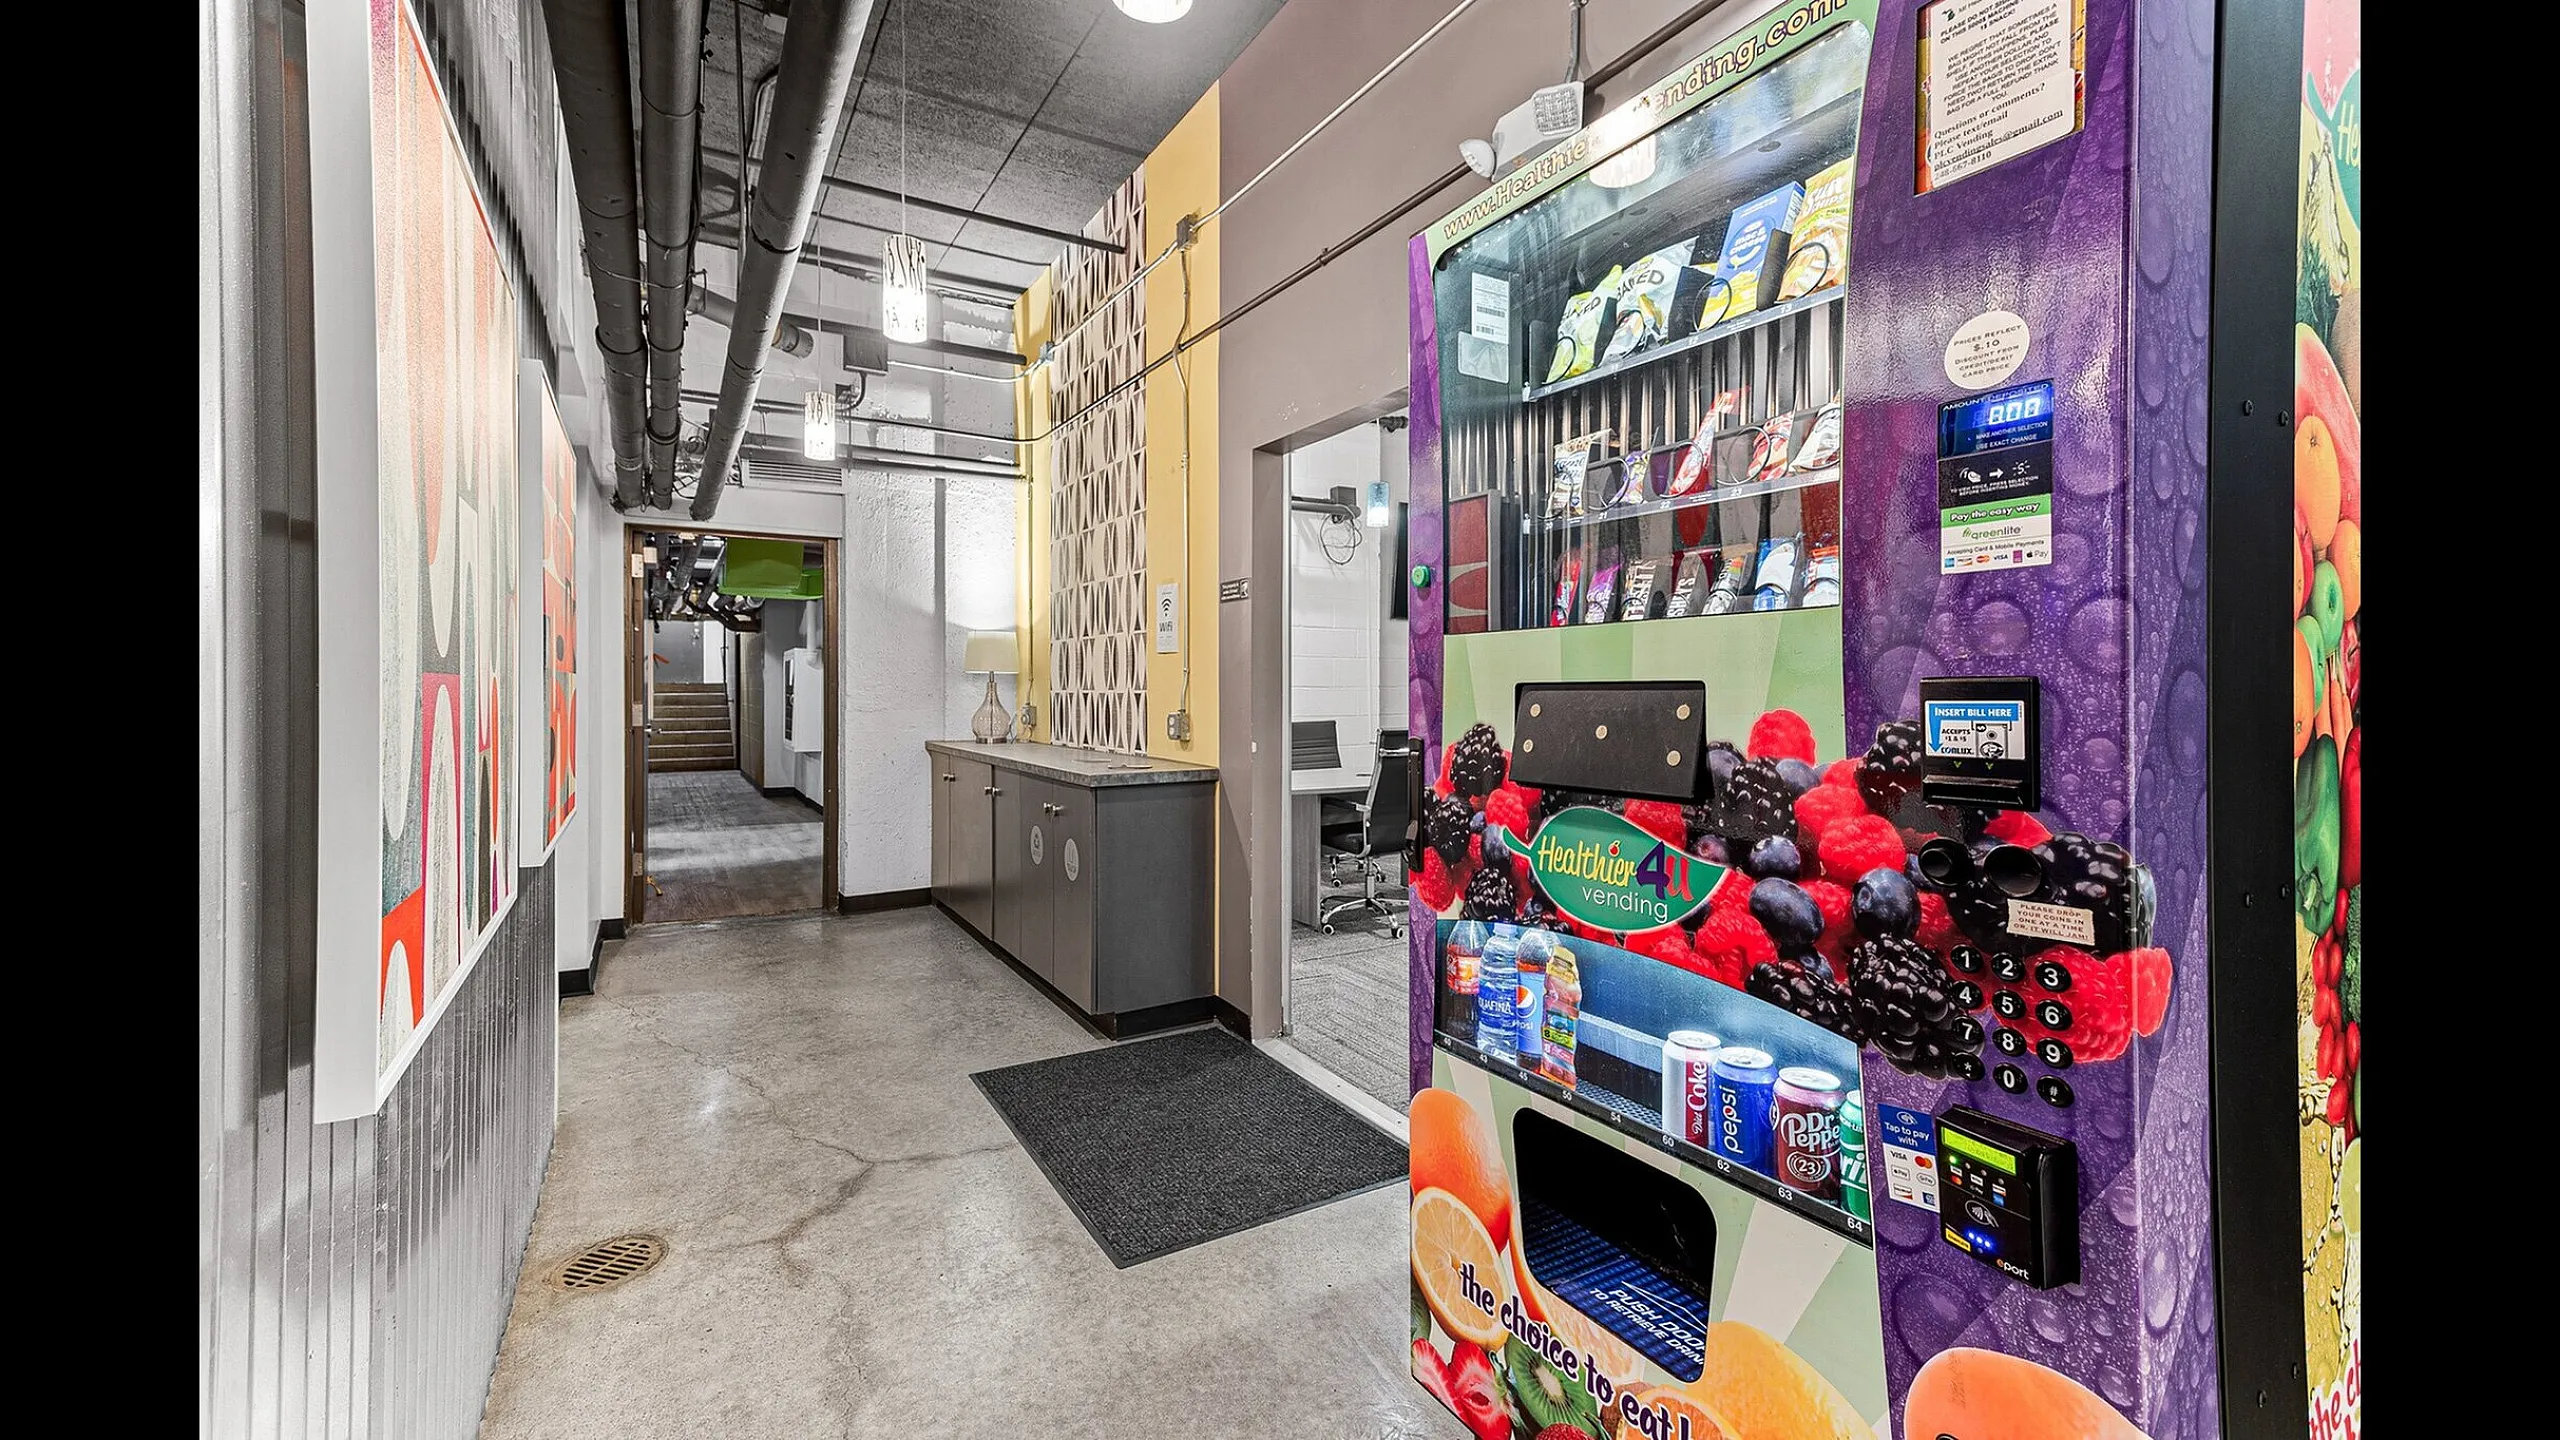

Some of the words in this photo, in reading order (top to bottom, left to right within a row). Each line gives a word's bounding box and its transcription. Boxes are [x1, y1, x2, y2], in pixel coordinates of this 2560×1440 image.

[1940, 19, 1966, 38] PLEASE
[1967, 13, 1977, 23] DO
[1980, 5, 1992, 16] NOT
[1948, 53, 1958, 63] WE
[1960, 38, 1987, 57] REGRET
[1989, 29, 2006, 42] THAT
[2008, 6, 2050, 33] SOMETIMES
[2051, 2, 2057, 10] A
[1940, 35, 1950, 45] ON
[1952, 26, 1966, 39] THIS
[1948, 59, 1961, 71] BAG
[1963, 48, 1983, 63] MIGHT
[1985, 39, 2000, 52] NOT
[2001, 30, 2017, 44] FALL
[2019, 19, 2040, 35] FROM
[2042, 10, 2057, 23] THE
[1977, 51, 1992, 64] THIS
[2029, 17, 2059, 37] PLEASE
[1952, 73, 1977, 91] REPEAT
[1979, 63, 1999, 78] YOUR
[2000, 42, 2040, 67] SELECTION
[2042, 37, 2052, 47] TO
[1955, 71, 1968, 82] USE
[1970, 54, 2002, 75] ANOTHER
[2004, 39, 2031, 58] DOLLAR
[2033, 30, 2049, 44] AND
[1944, 86, 1966, 102] FORCE
[1967, 79, 1981, 91] THE
[2005, 63, 2014, 73] TO
[1946, 104, 1961, 116] BAG
[1961, 97, 1976, 109] FOR
[1977, 94, 1982, 102] A
[1983, 86, 1999, 99] FULL
[2034, 58, 2059, 75] THANK
[1947, 94, 1966, 108] NEED
[1987, 70, 2016, 89] RETURN
[2017, 63, 2031, 75] THE
[2033, 50, 2058, 68] EXTRA
[1934, 113, 1977, 141] Questions
[1979, 109, 1990, 121] or
[1991, 82, 2045, 115] comments?
[1934, 131, 1961, 149] Please
[1963, 110, 2008, 137] text/email
[1934, 145, 1953, 160] PLC
[1956, 128, 1993, 151] Vending
[1955, 351, 1993, 365] DISCOUNT
[1997, 344, 2019, 354] FROM
[1962, 368, 1984, 378] CARD
[1943, 397, 1984, 412] AMOUNT
[2017, 421, 2048, 433] SELECTION
[1989, 438, 2009, 448] EXACT
[2010, 434, 2037, 445] CHANGE
[1950, 512, 1969, 524] Pay
[1971, 509, 1987, 521] the
[1989, 506, 2013, 519] easy
[2016, 502, 2040, 515] way
[1971, 524, 2021, 540] greenlite
[1947, 548, 1973, 556] Accepting
[1995, 542, 2014, 550] Mobile
[2015, 538, 2045, 548] Payments
[1934, 708, 1966, 717] INSERT
[1967, 708, 1986, 717] BILL
[1988, 708, 2012, 717] HERE
[1538, 835, 1637, 888] Healthier
[1581, 886, 1668, 923] vending
[2021, 904, 2053, 913] PLEASE
[2057, 909, 2081, 918] DROP
[2017, 910, 2041, 918] YOUR
[2043, 914, 2071, 923] COINS
[2019, 917, 2036, 925] ONE
[2061, 924, 2084, 932] TIME
[2041, 927, 2064, 936] WILL
[2066, 932, 2088, 941] JAM!
[1961, 950, 1970, 968] 1
[2001, 958, 2014, 976] 2
[2043, 967, 2059, 987] 3
[1959, 986, 1972, 1004] 4
[2001, 996, 2014, 1015] 5
[2044, 1006, 2060, 1025] 6
[1961, 1022, 1973, 1041] 7
[2002, 1032, 2015, 1051] 8
[2045, 1044, 2061, 1063] 9
[1519, 1071, 1528, 1081] 45
[1687, 1061, 1707, 1112] Coke
[2003, 1069, 2015, 1089] 0
[1562, 1090, 1573, 1101] 50
[1610, 1111, 1621, 1123] 54
[1719, 1085, 1744, 1154] pepsi
[1807, 1112, 1835, 1134] Dr
[1662, 1134, 1674, 1147] 60
[1780, 1113, 1840, 1152] Peppe
[1884, 1121, 1901, 1133] Tap
[1901, 1126, 1912, 1135] to
[1913, 1130, 1929, 1141] pay
[1897, 1136, 1918, 1147] with
[1798, 1158, 1817, 1174] 23
[1890, 1150, 1908, 1160] VISA
[1717, 1160, 1731, 1173] 62
[1778, 1187, 1793, 1200] 63
[1847, 1217, 1863, 1232] 64
[1996, 1258, 2029, 1280] eport
[1608, 1289, 1663, 1320] PUSH
[1459, 1263, 1496, 1312] the
[1501, 1296, 1578, 1380] choice
[1584, 1353, 1614, 1404] to
[1590, 1287, 1609, 1300] TO
[1606, 1300, 1669, 1340] RETRIEVE
[1665, 1338, 1704, 1365] DRIN
